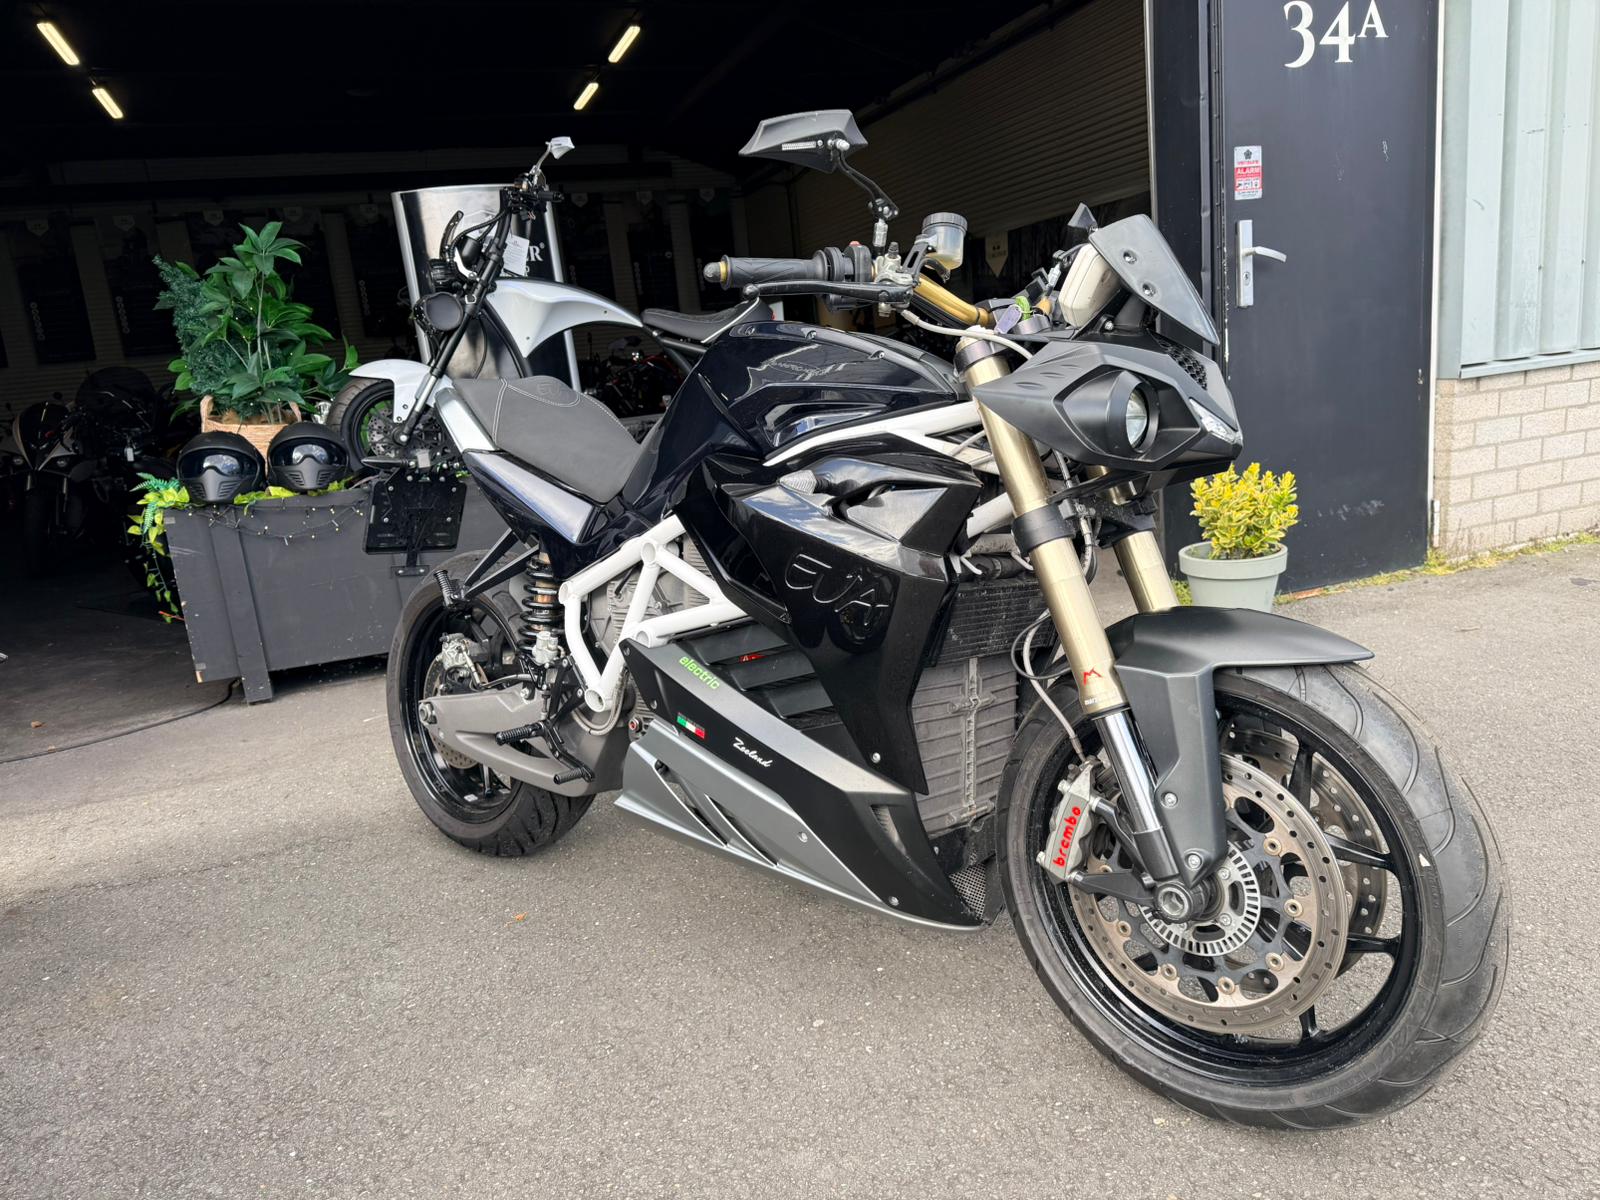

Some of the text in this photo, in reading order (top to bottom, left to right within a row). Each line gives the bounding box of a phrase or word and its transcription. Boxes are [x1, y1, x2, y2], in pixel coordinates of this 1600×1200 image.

[1283, 0, 1389, 69] 34A
[1237, 167, 1260, 175] ALARM
[679, 656, 720, 689] electric
[732, 737, 773, 768] Zeeland
[1053, 806, 1082, 868] brembo
